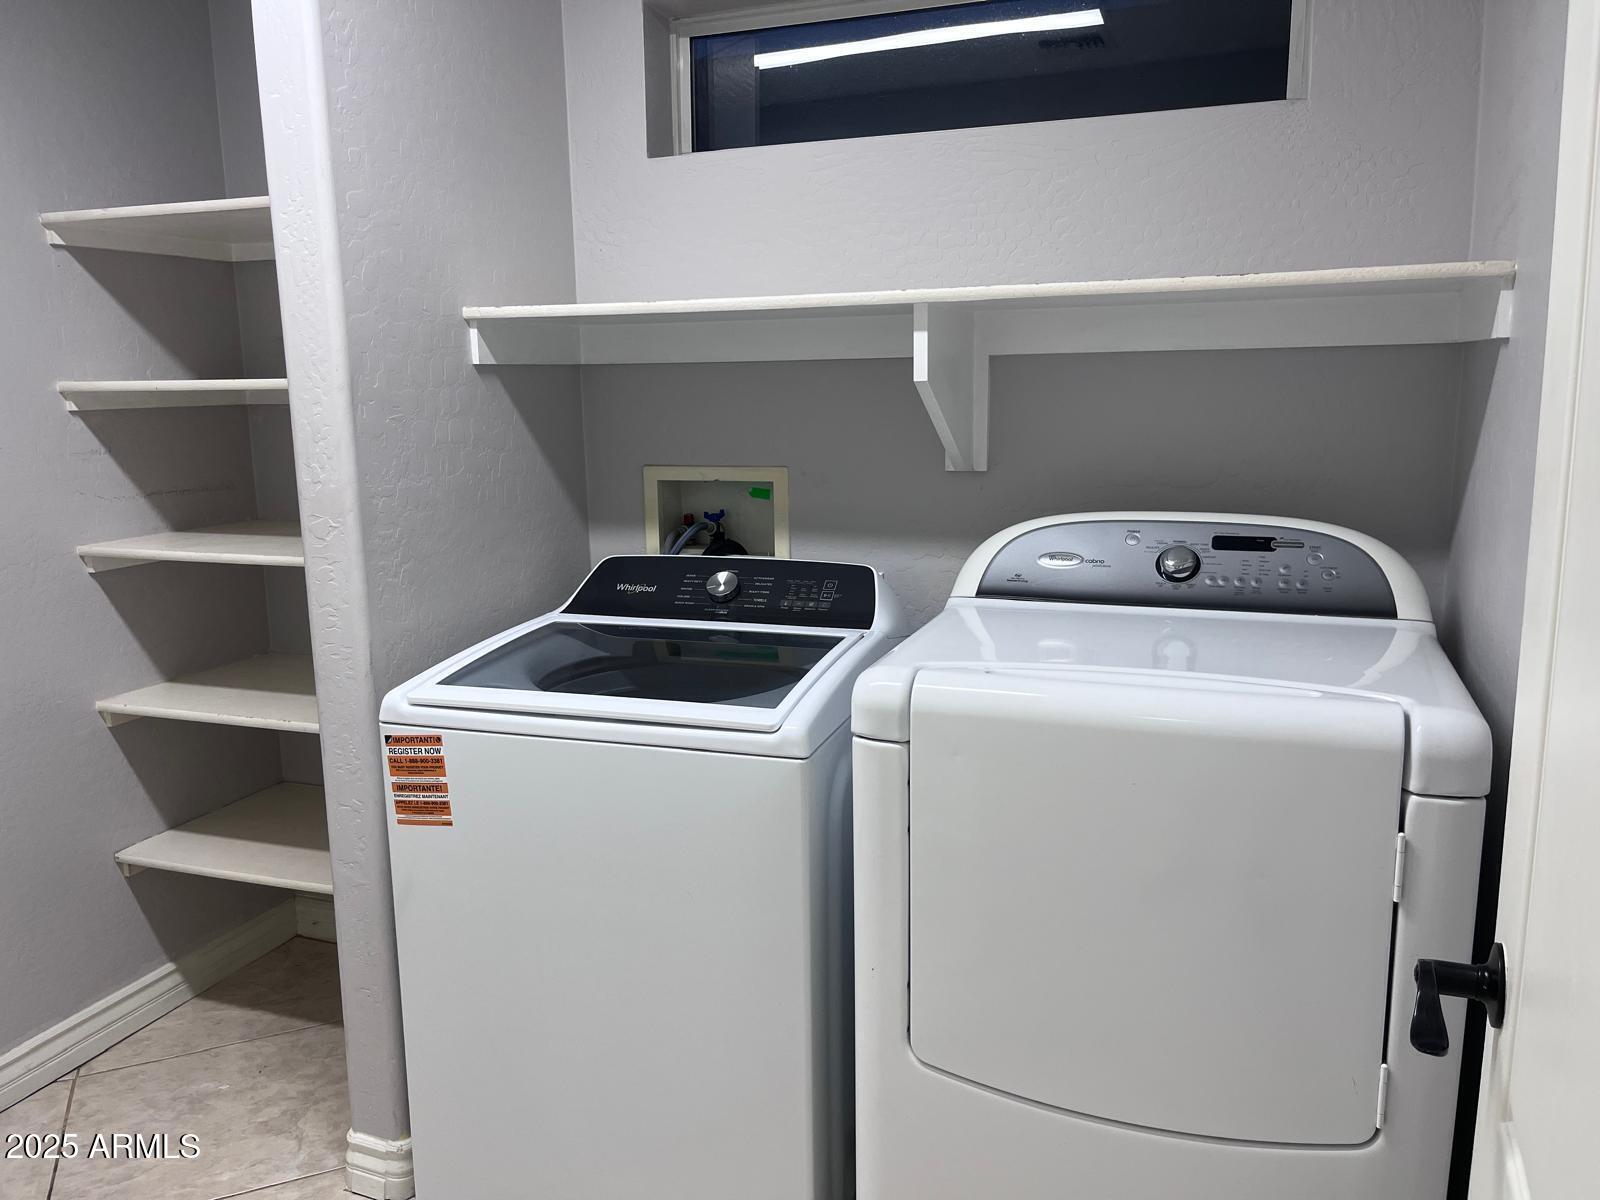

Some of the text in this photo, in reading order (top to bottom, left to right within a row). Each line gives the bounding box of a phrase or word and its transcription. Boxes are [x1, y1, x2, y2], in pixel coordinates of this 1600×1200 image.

[1048, 554, 1073, 562] Whirlpool
[616, 583, 657, 593] Whirlpool
[388, 747, 442, 755] REGISTER NOW
[396, 784, 442, 792] IMPORTANTE!
